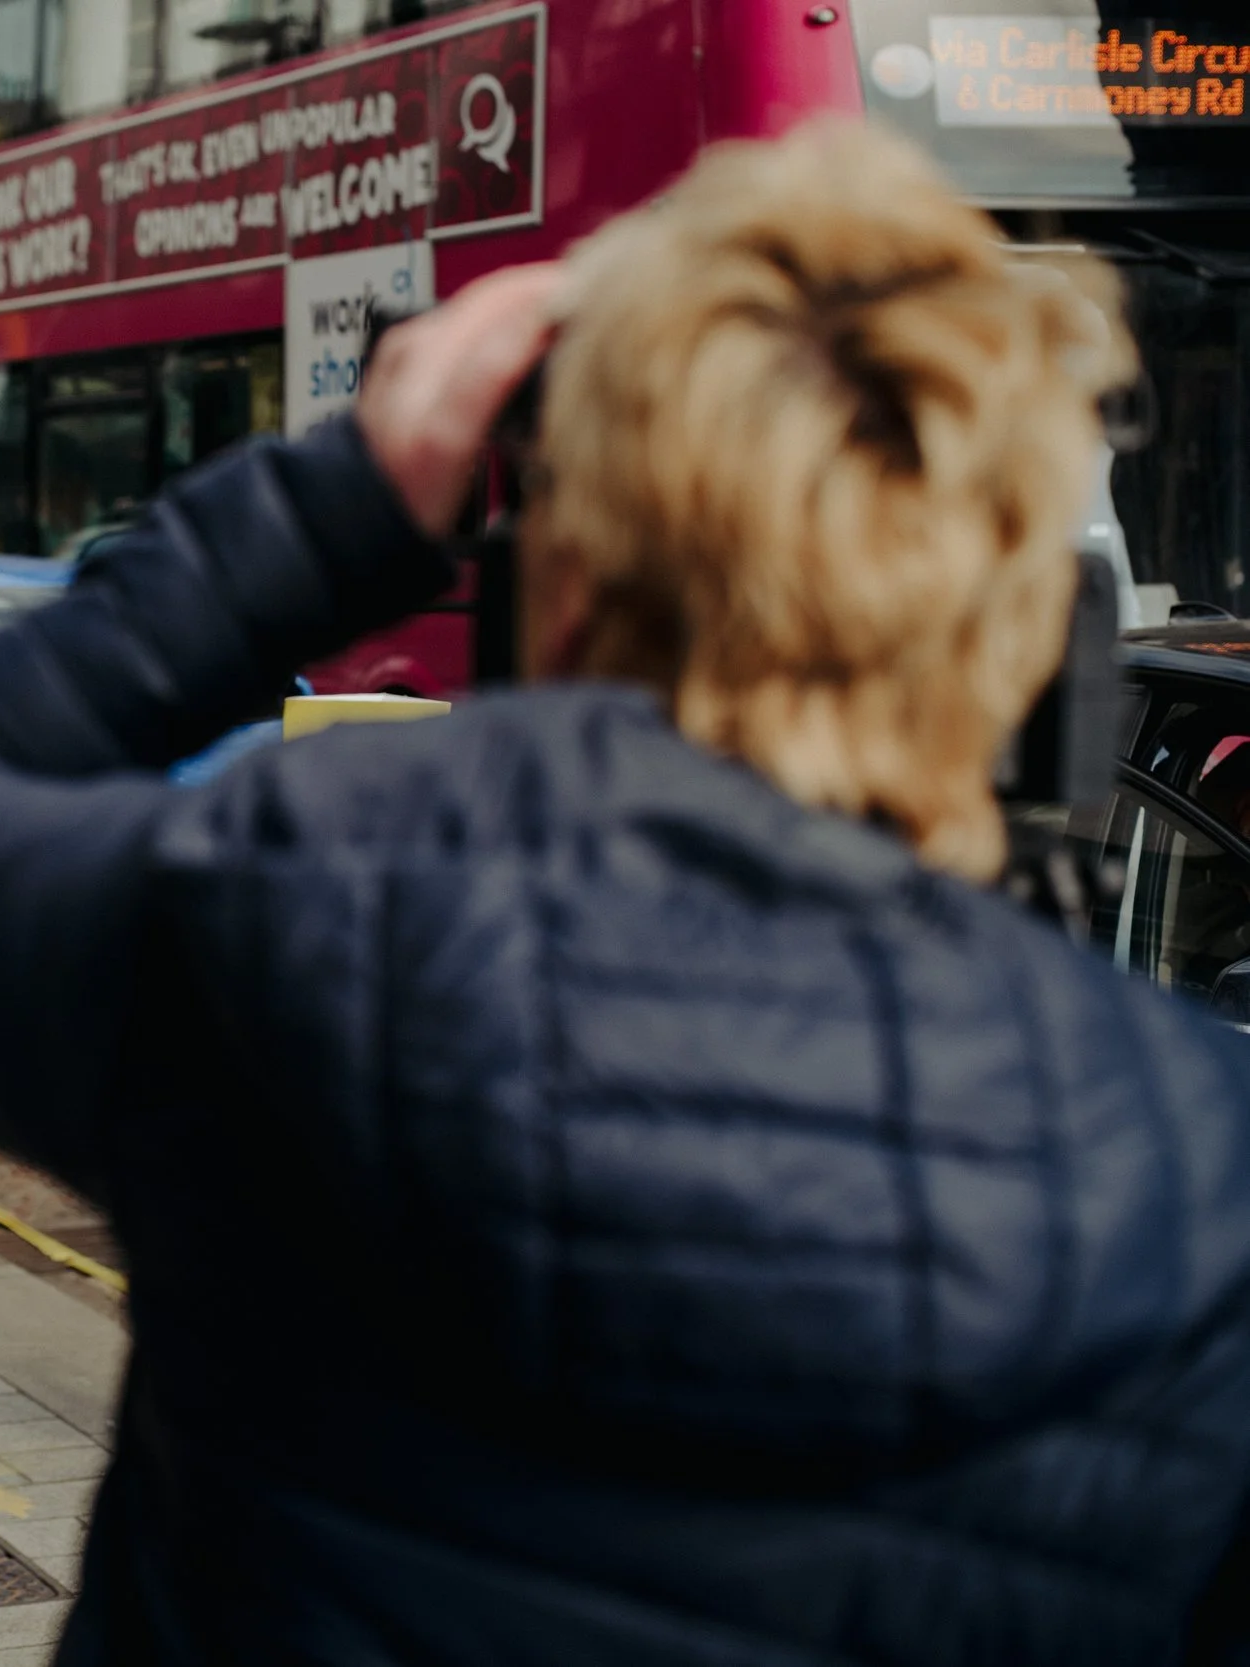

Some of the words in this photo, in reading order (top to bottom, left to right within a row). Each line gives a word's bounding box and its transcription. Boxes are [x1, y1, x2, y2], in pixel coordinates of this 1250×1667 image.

[1000, 25, 1143, 72] Carlisle
[1196, 77, 1244, 116] Rd
[201, 121, 259, 178] EVEN
[260, 91, 396, 155] UNPOPULAR
[25, 156, 77, 221] OUR
[7, 213, 91, 288] WORK?
[134, 197, 238, 257] OPINIONS
[311, 347, 363, 398] sho
